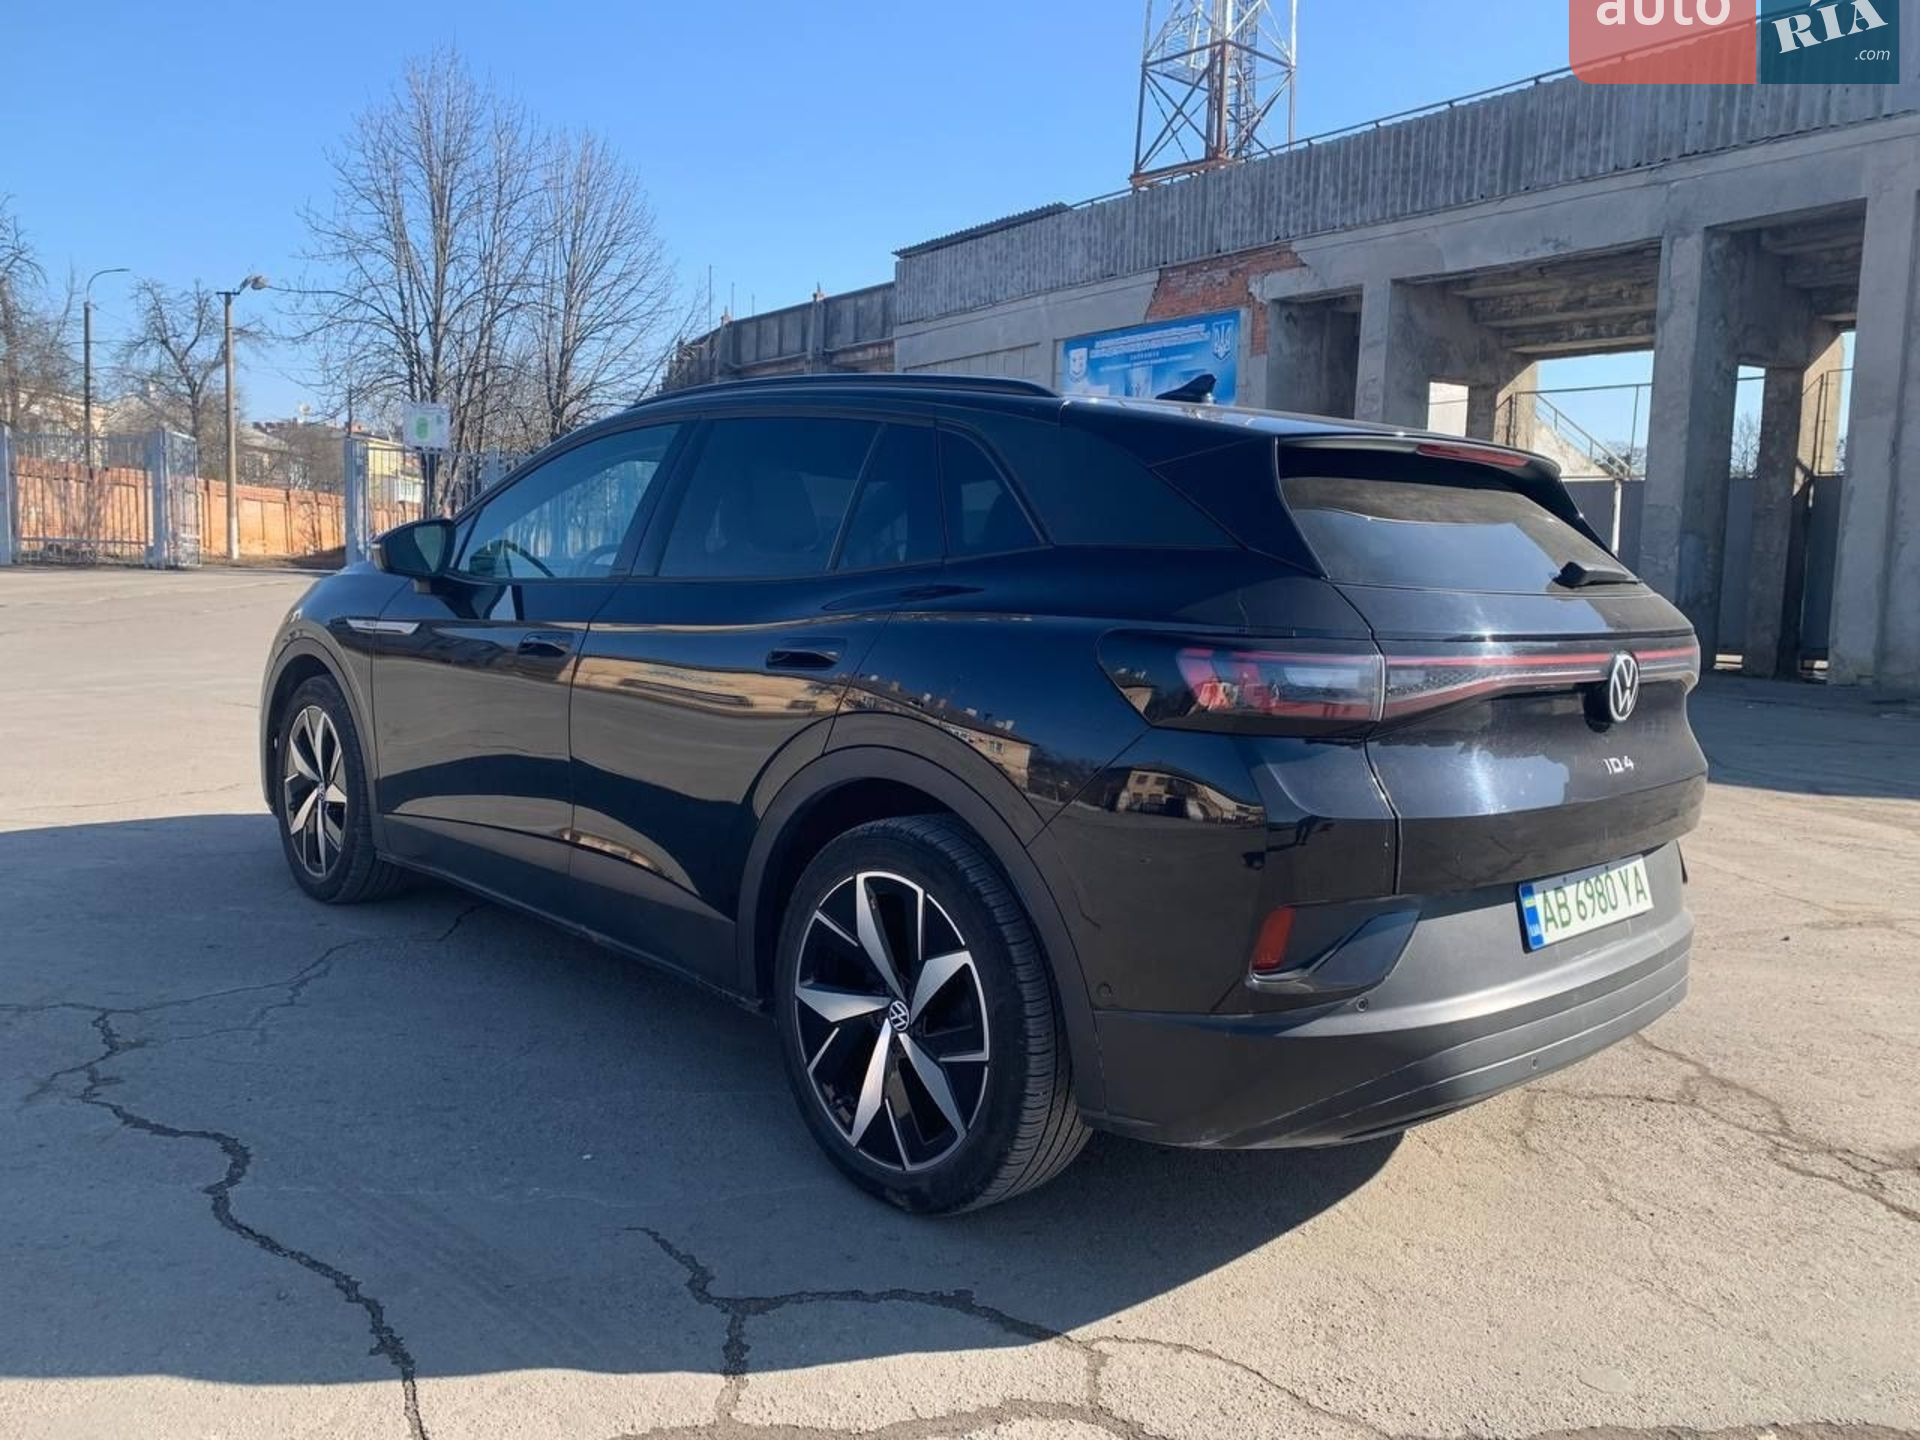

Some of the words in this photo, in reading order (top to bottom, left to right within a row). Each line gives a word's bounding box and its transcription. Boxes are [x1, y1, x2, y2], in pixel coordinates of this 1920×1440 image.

[1542, 886, 1572, 932] AB
[1575, 873, 1618, 921] 6980
[1619, 865, 1648, 906] YA
